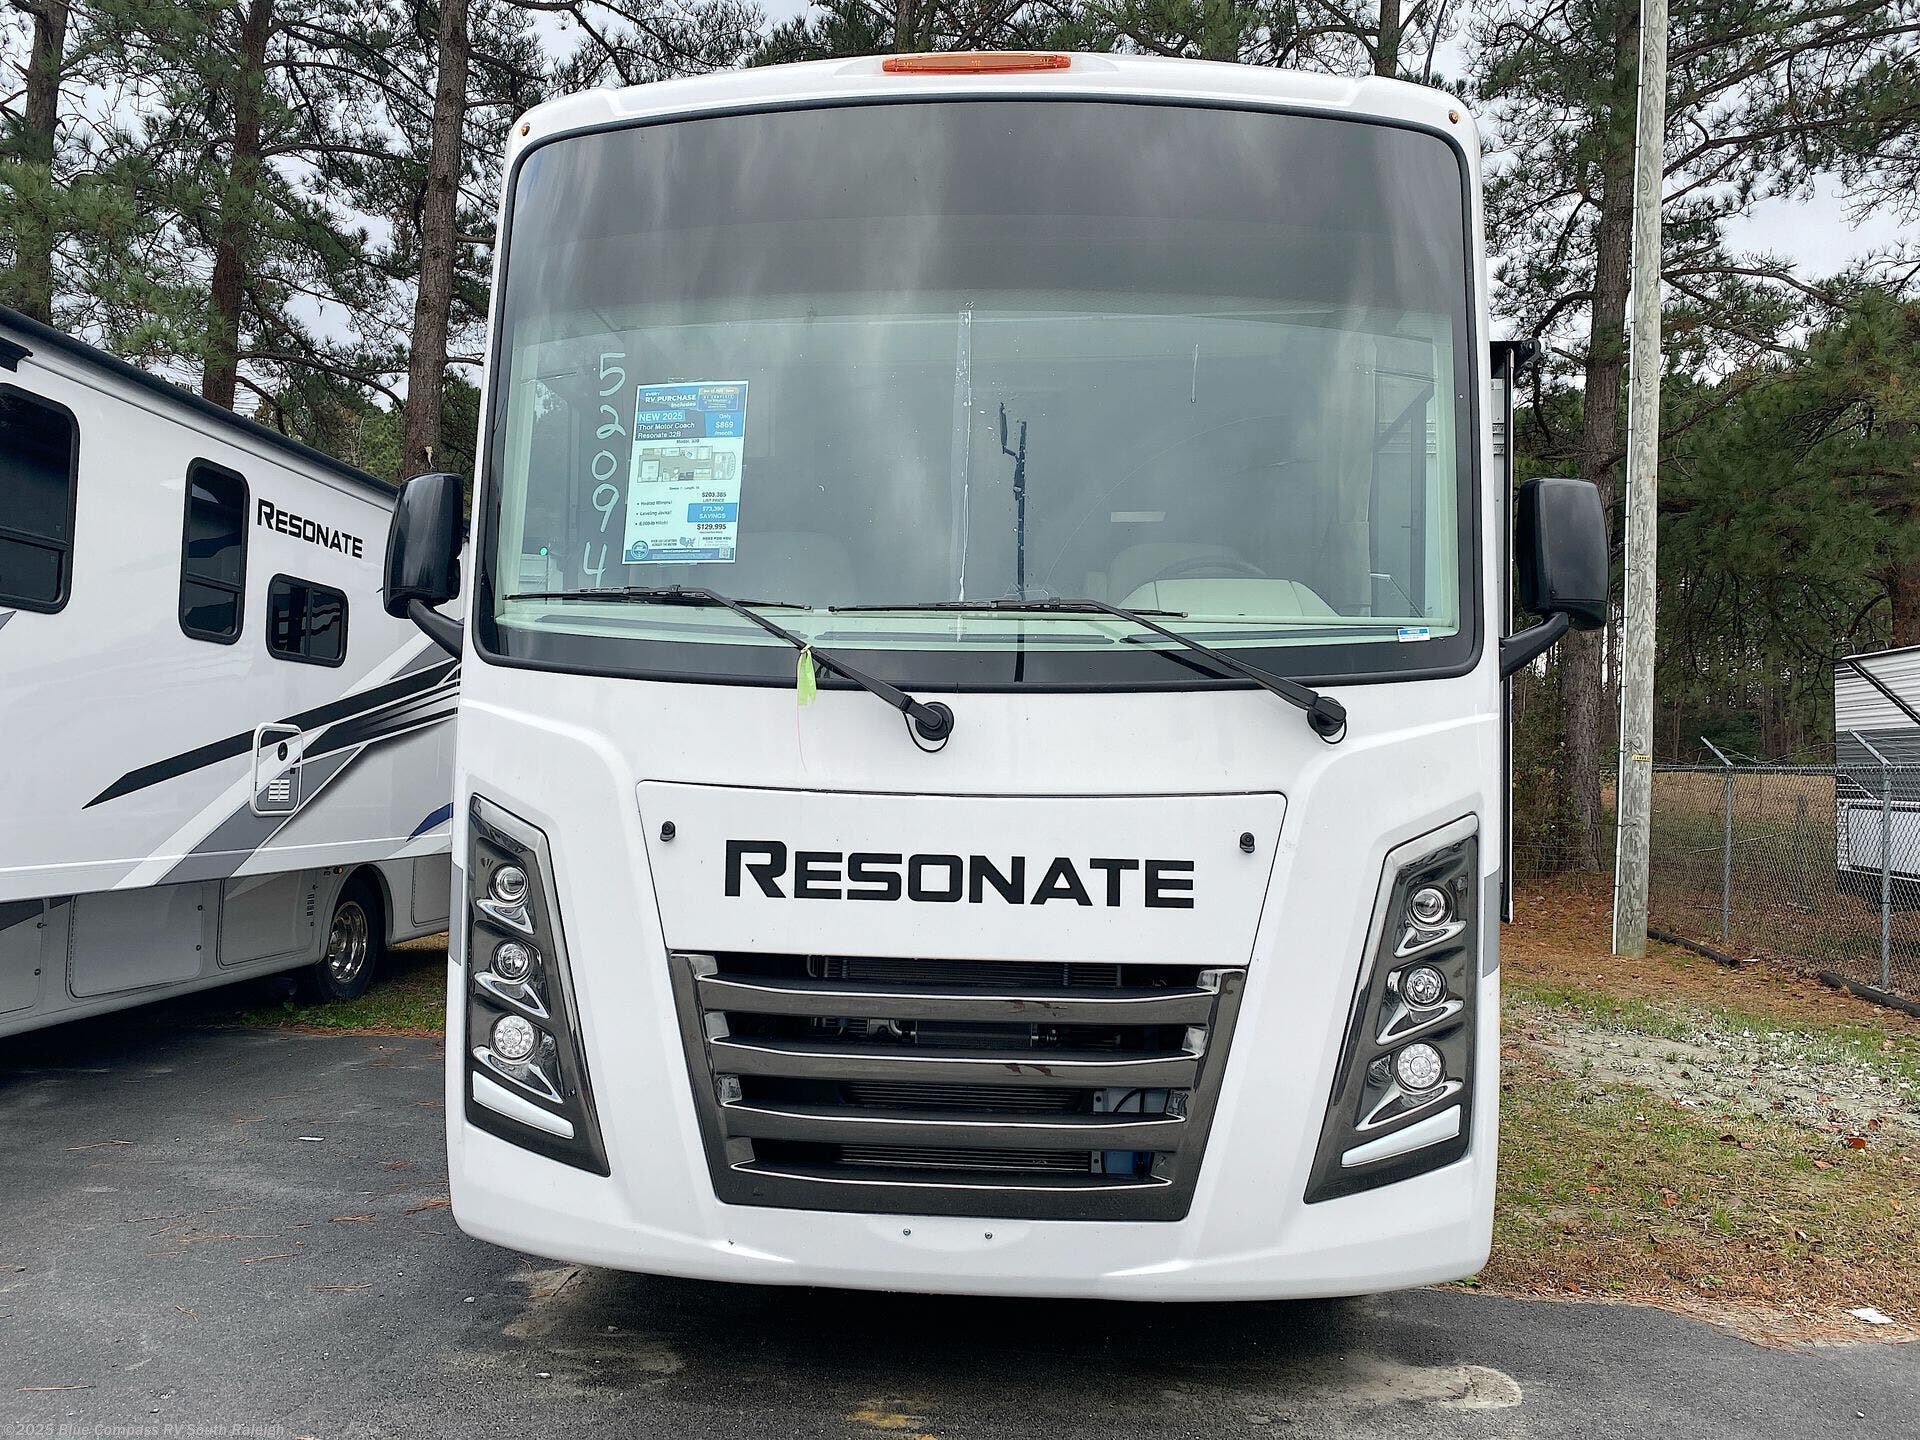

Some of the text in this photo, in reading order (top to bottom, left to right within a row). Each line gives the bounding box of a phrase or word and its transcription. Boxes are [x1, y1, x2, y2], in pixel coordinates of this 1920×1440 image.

[657, 394, 697, 402] PURCHASE
[639, 412, 683, 421] NEW 2025
[719, 413, 731, 421] Only
[715, 421, 734, 429] $869
[637, 431, 668, 439] Resonate
[583, 352, 626, 587] 52094
[724, 839, 1195, 909] RESONATE
